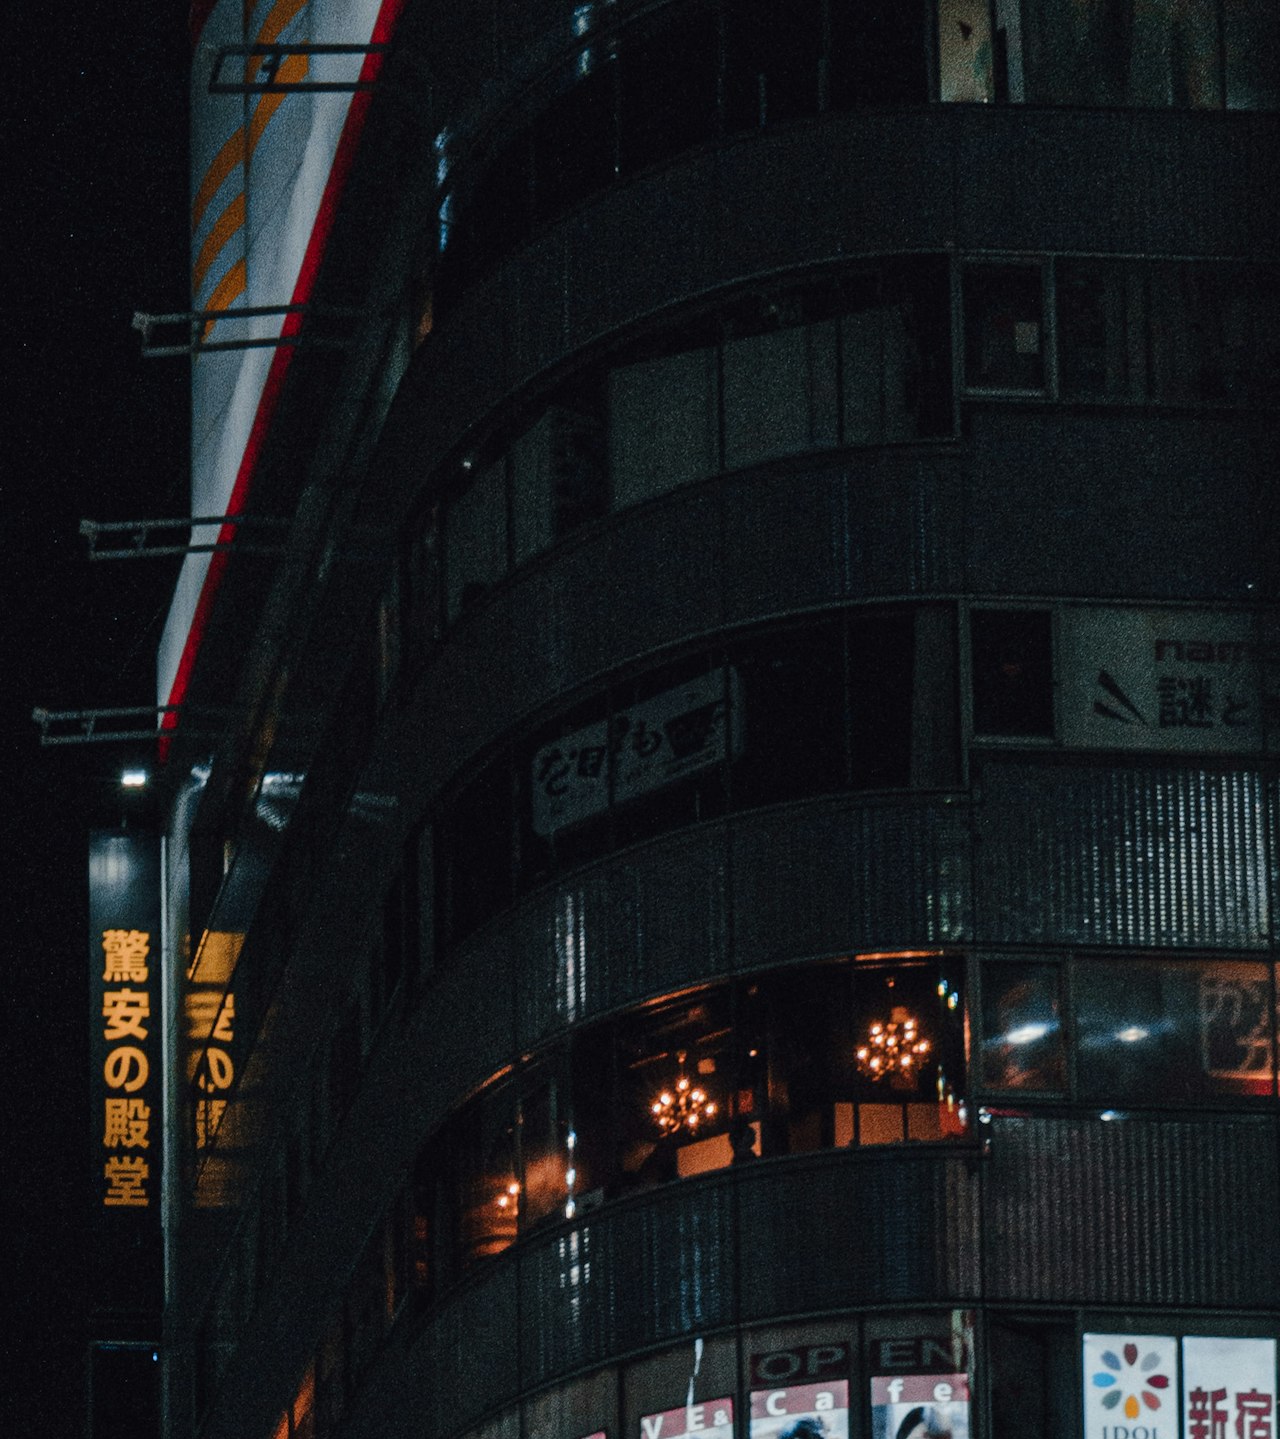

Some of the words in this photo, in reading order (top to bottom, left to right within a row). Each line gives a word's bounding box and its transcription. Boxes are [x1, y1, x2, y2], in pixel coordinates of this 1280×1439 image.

[101, 928, 151, 1207] 驚安の殿堂
